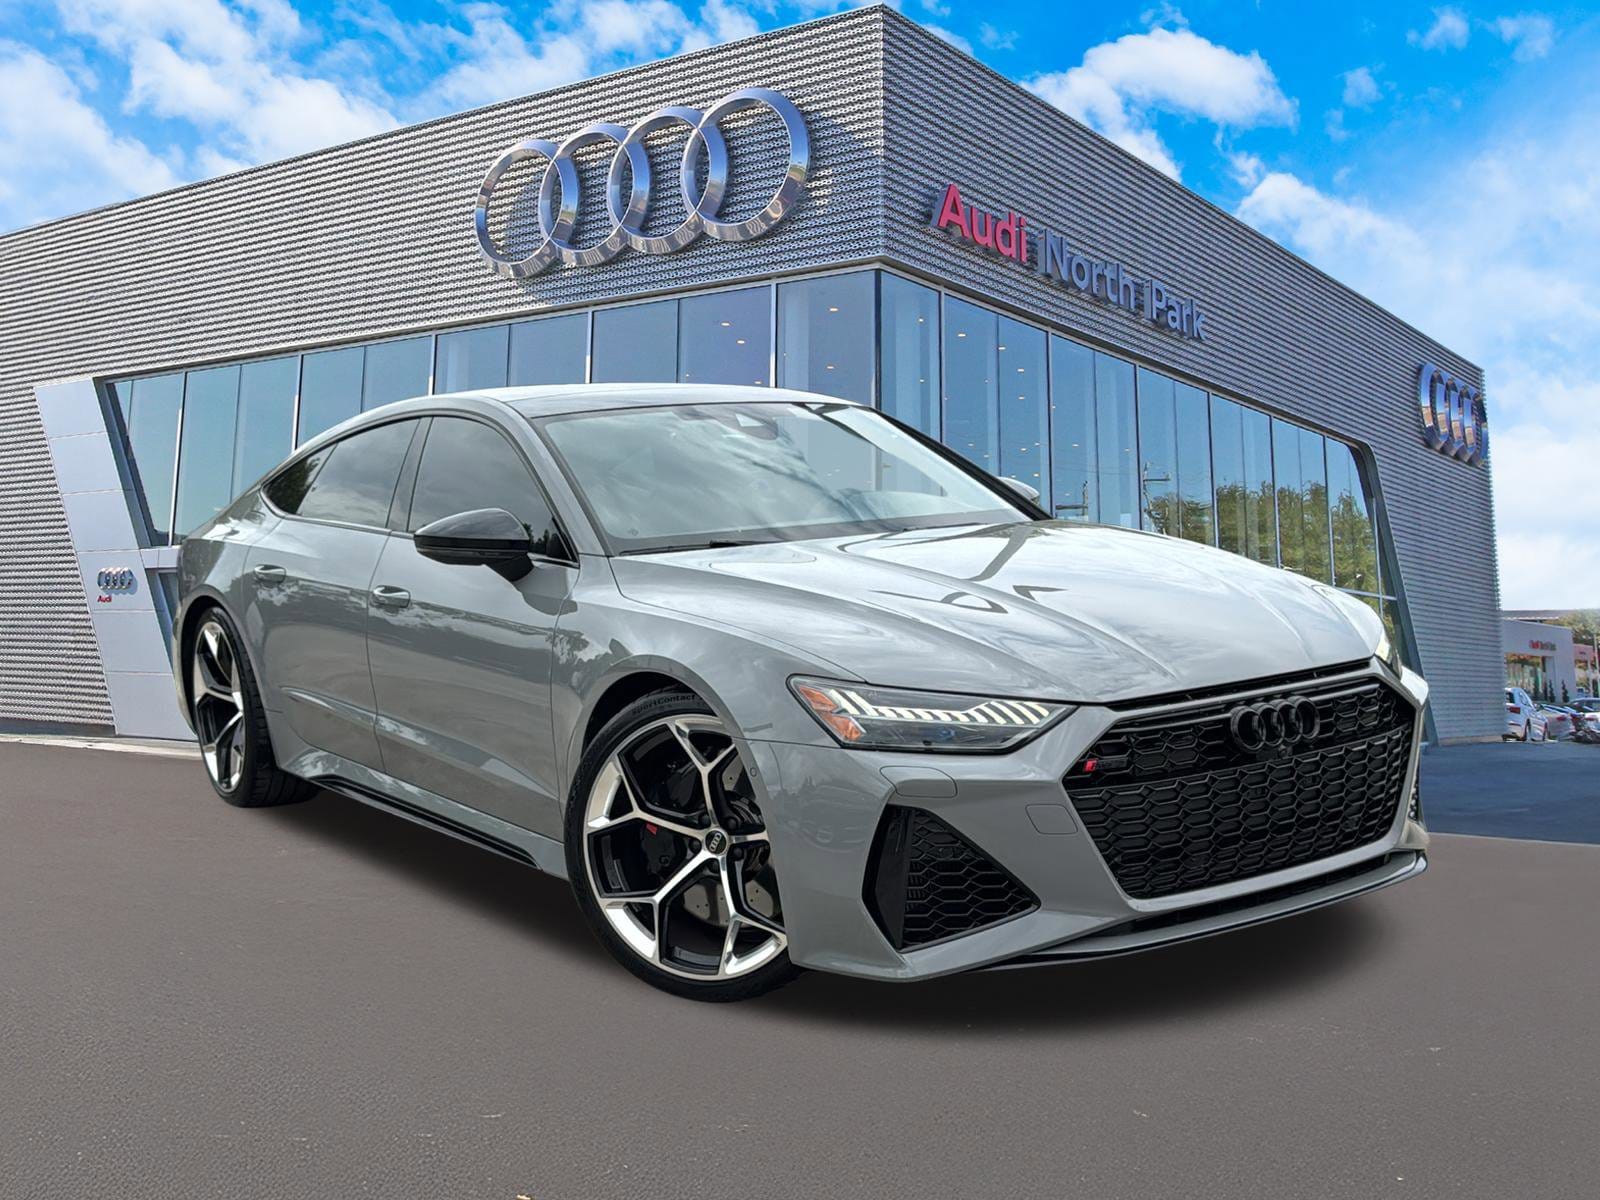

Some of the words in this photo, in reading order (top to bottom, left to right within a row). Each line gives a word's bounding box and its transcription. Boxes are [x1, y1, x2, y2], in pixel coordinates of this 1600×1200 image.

[935, 184, 1028, 264] Audi
[1041, 229, 1136, 310] North
[1148, 279, 1208, 340] Park
[97, 595, 112, 603] Audi
